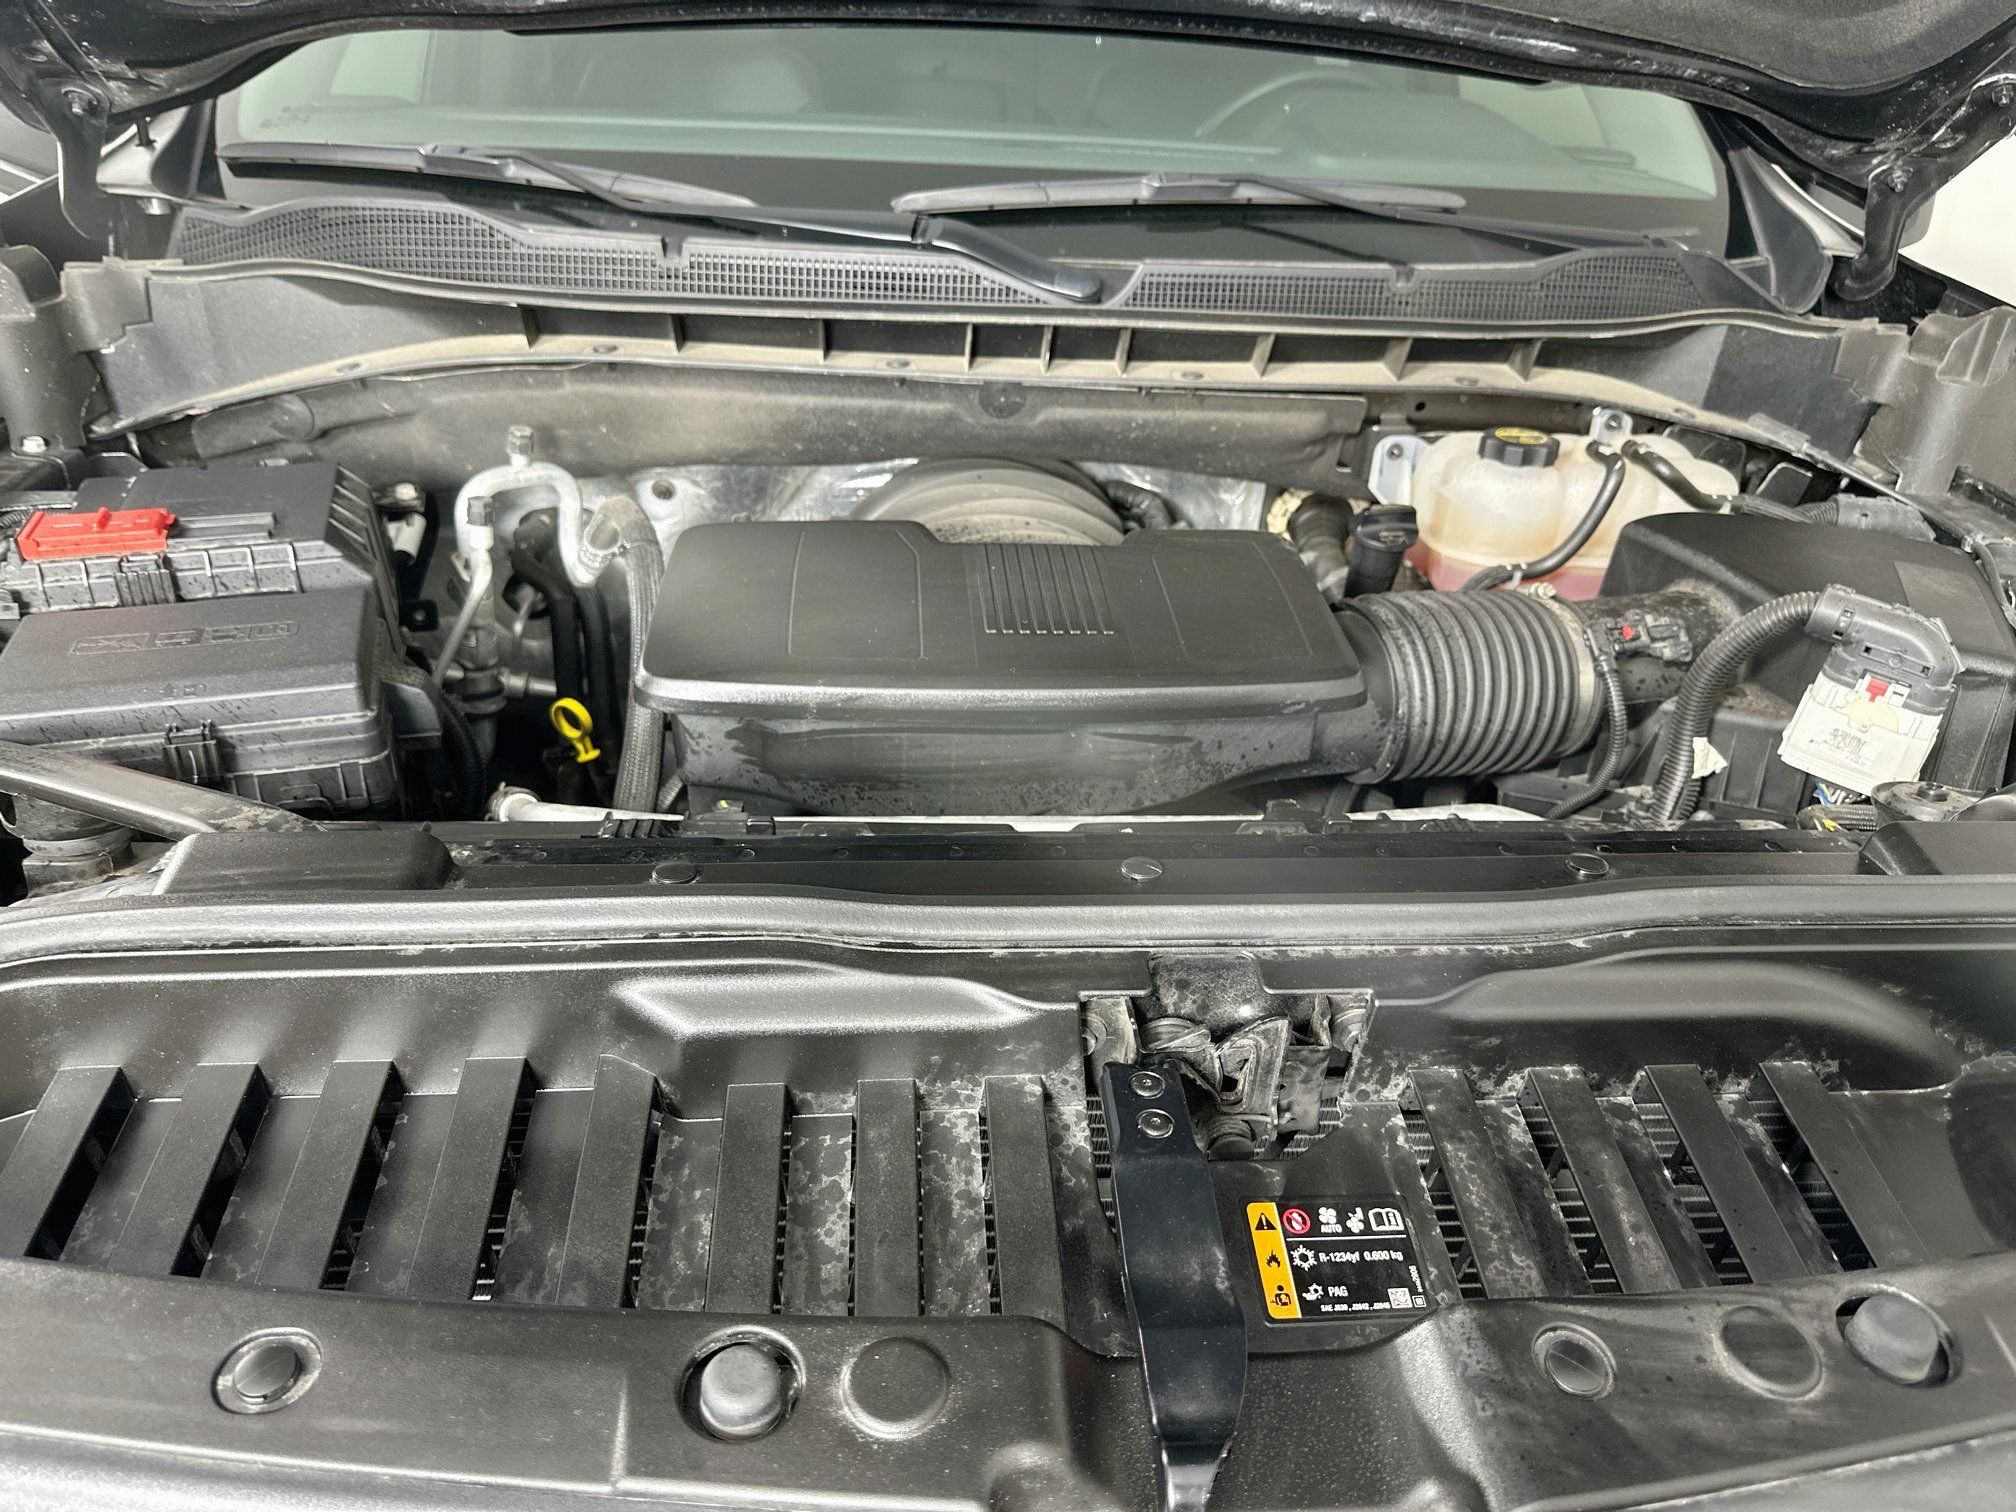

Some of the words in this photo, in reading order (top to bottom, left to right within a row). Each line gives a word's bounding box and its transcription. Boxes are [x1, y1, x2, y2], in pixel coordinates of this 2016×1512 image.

[1320, 1224, 1342, 1233] AUTO
[1319, 1251, 1360, 1263] R-1234yf
[1364, 1250, 1390, 1261] 0.600
[1390, 1250, 1404, 1261] kg
[1328, 1286, 1348, 1297] PAG
[1321, 1304, 1333, 1312] SAE
